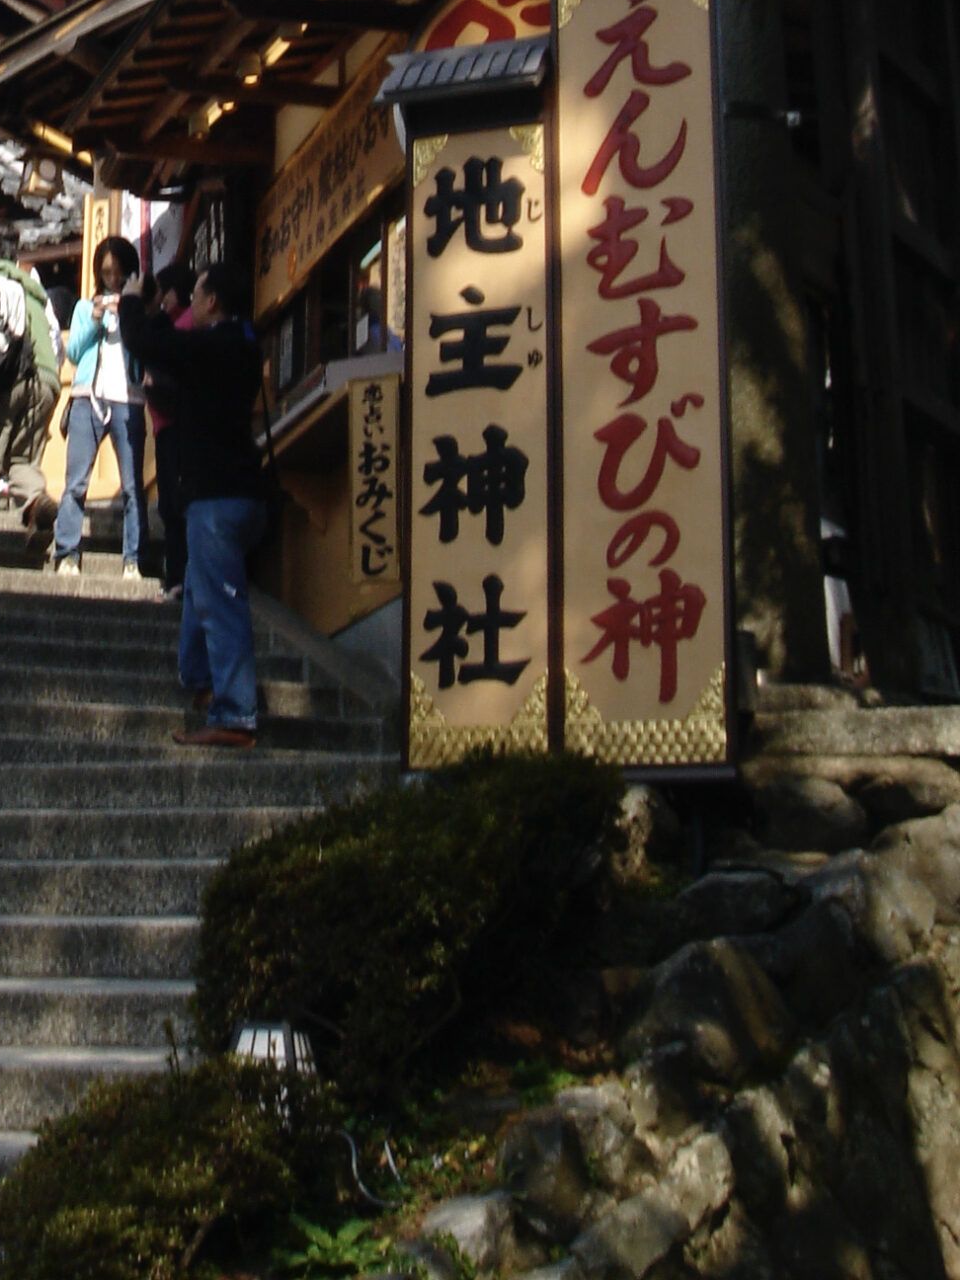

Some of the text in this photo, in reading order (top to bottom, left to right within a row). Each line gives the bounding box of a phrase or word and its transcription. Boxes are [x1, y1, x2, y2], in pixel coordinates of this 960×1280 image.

[526, 198, 543, 222] じ
[417, 155, 531, 691] 地主神社
